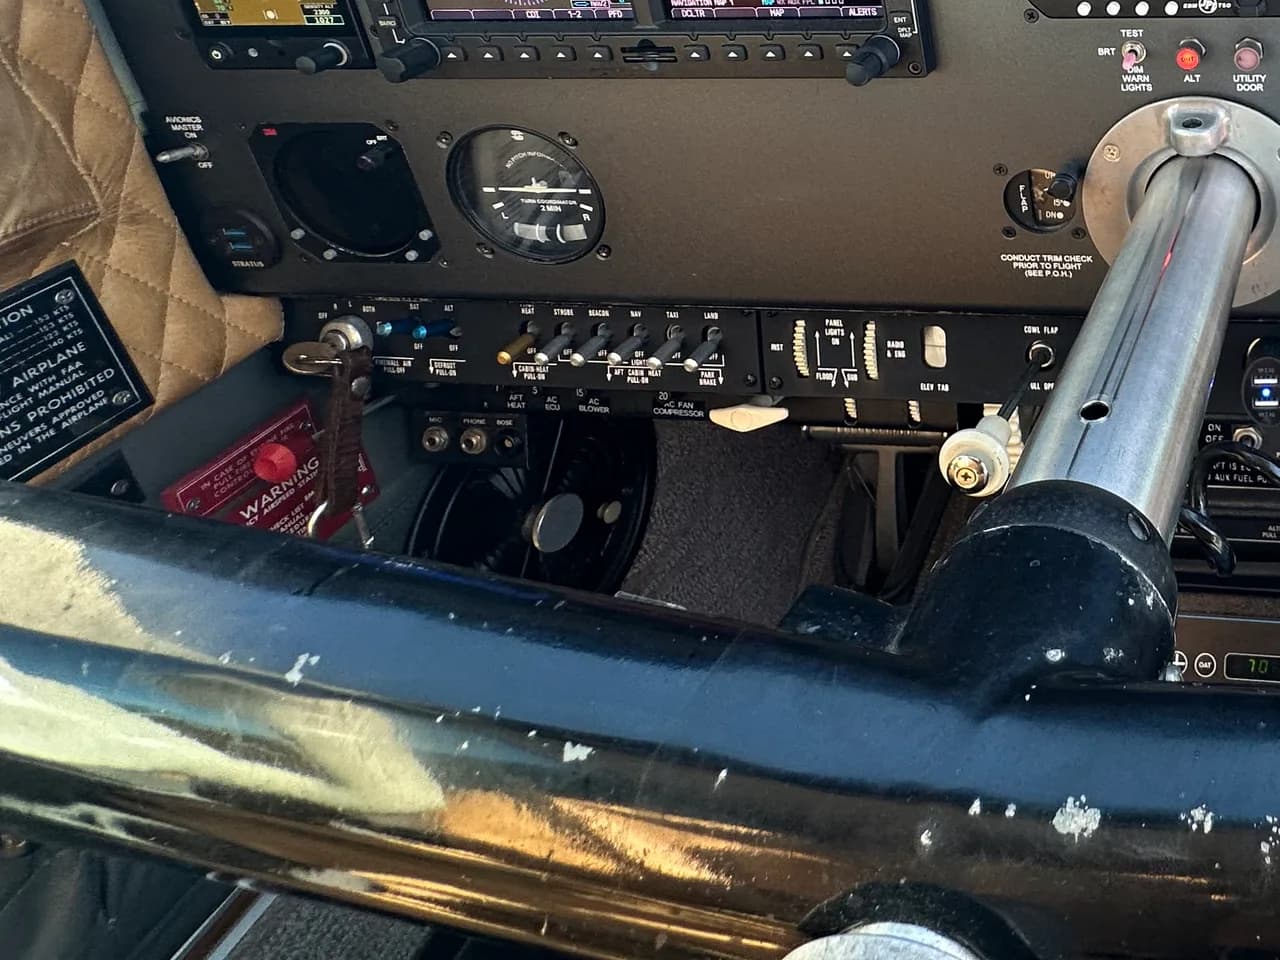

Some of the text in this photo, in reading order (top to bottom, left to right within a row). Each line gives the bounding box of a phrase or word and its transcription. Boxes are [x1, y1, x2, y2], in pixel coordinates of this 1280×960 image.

[607, 10, 623, 18] PFD
[681, 8, 706, 18] DCLTR
[770, 8, 785, 16] MAP
[848, 7, 878, 16] ALERTS
[894, 16, 908, 24] ENT
[1098, 47, 1116, 56] BRT
[1121, 75, 1150, 83] WARN
[1183, 75, 1201, 83] ALT
[1232, 74, 1266, 82] UTILITY
[1066, 255, 1093, 263] CHECK
[12, 341, 86, 387] AIRPLANE
[27, 368, 115, 422] PROHIBITED
[52, 390, 104, 424] APPROVED
[578, 405, 610, 414] BLOWER
[653, 409, 704, 418] COMPRESSOR
[239, 456, 321, 519] WARNING
